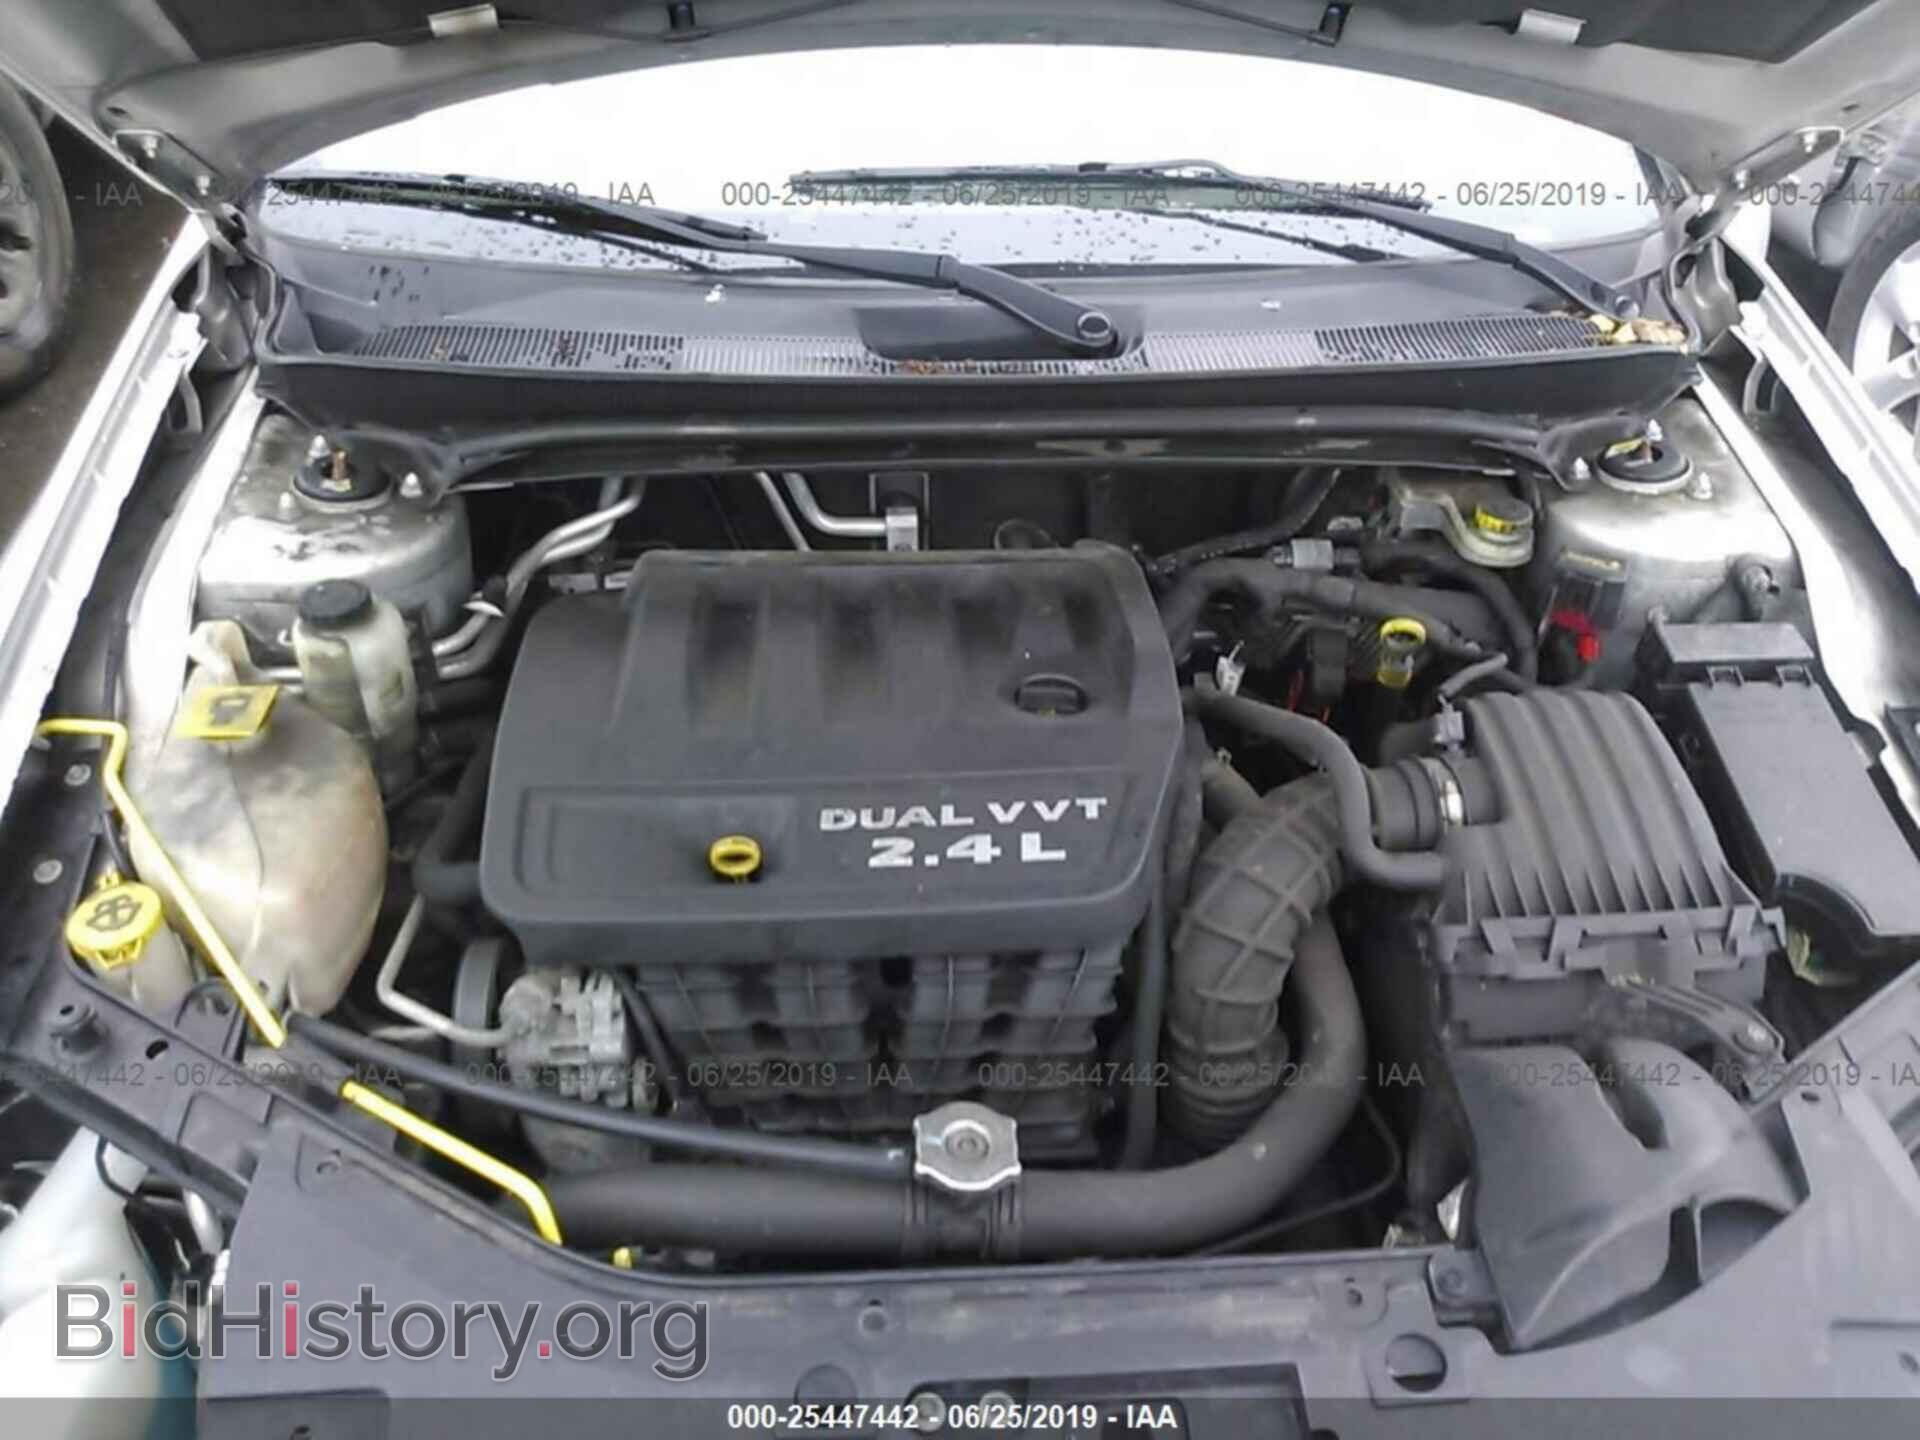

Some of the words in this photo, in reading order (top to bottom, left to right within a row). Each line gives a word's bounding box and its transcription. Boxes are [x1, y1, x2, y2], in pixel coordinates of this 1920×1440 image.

[819, 804, 974, 830] DUAL
[987, 797, 1107, 824] VVT
[868, 833, 1002, 868] 2.4
[1020, 831, 1067, 862] L
